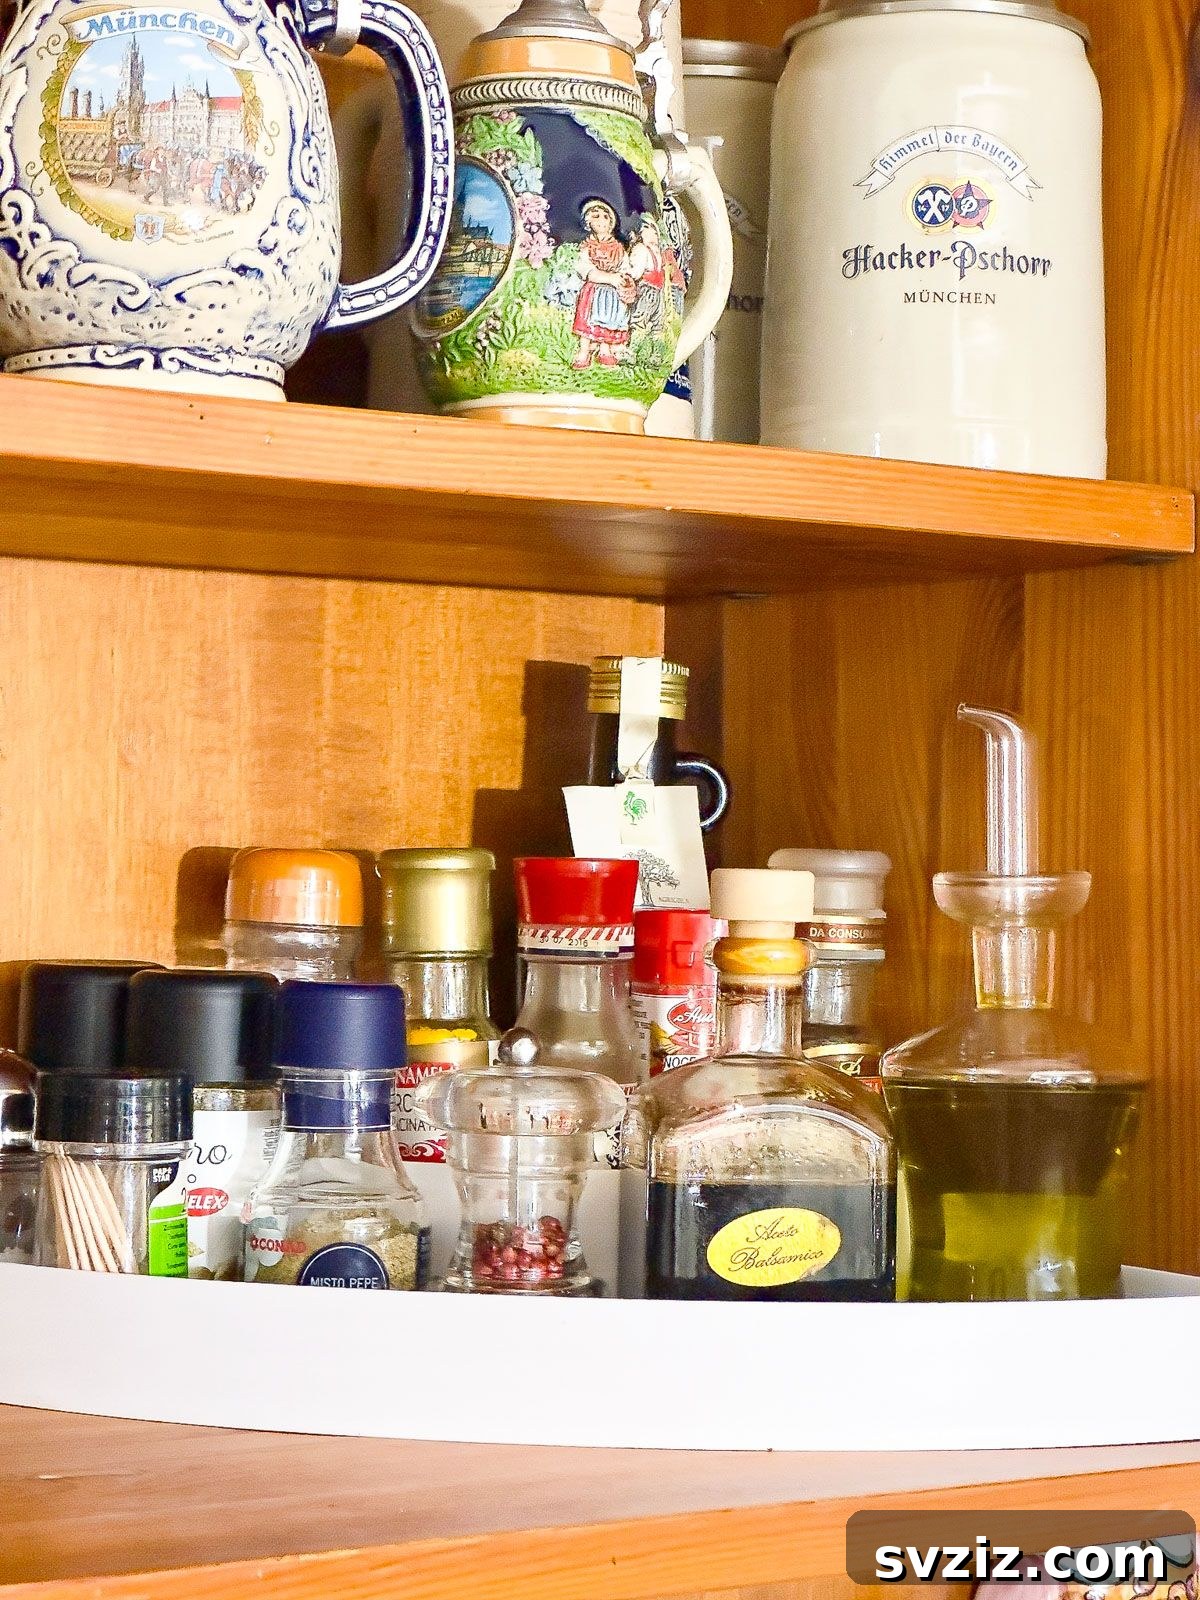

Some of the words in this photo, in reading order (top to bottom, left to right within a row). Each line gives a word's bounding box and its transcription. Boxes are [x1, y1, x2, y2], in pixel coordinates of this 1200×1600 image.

[76, 11, 235, 45] München
[879, 133, 934, 171] Himmel
[944, 131, 967, 144] der
[972, 133, 1018, 172] Bayern
[841, 241, 1053, 281] Hacker-Pschorr
[903, 289, 997, 305] MÜNCHEN
[809, 927, 825, 937] DA
[187, 1195, 226, 1211] ELEX
[746, 1216, 799, 1243] Aceto
[728, 1246, 825, 1272] Balsamico
[349, 1277, 379, 1289] PEPE
